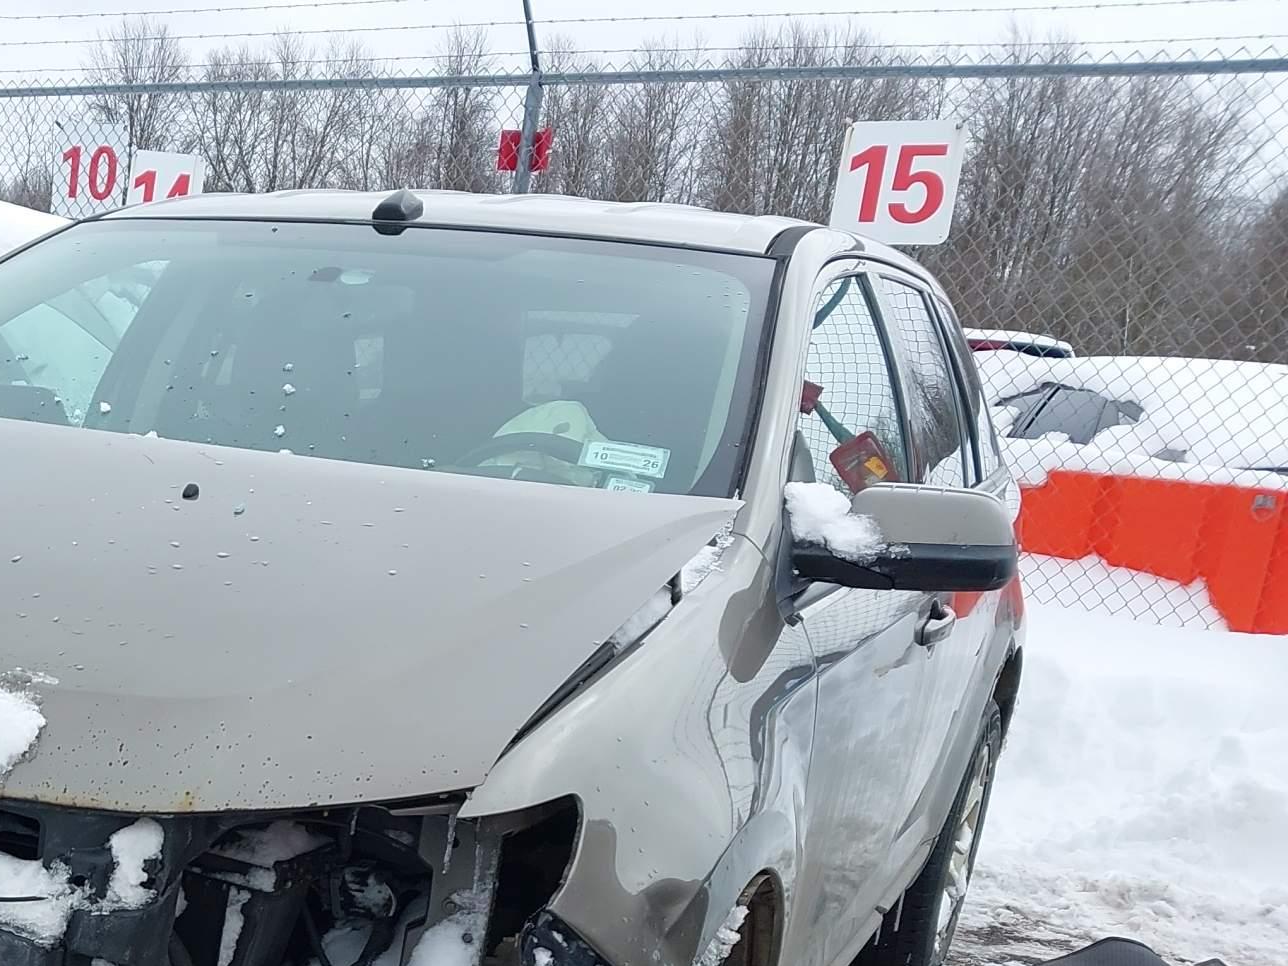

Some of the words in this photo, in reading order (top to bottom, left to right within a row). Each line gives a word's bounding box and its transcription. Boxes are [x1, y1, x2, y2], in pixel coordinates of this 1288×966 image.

[63, 146, 119, 201] 10
[850, 144, 948, 224] 15
[593, 452, 609, 460] 10
[642, 459, 659, 469] 26
